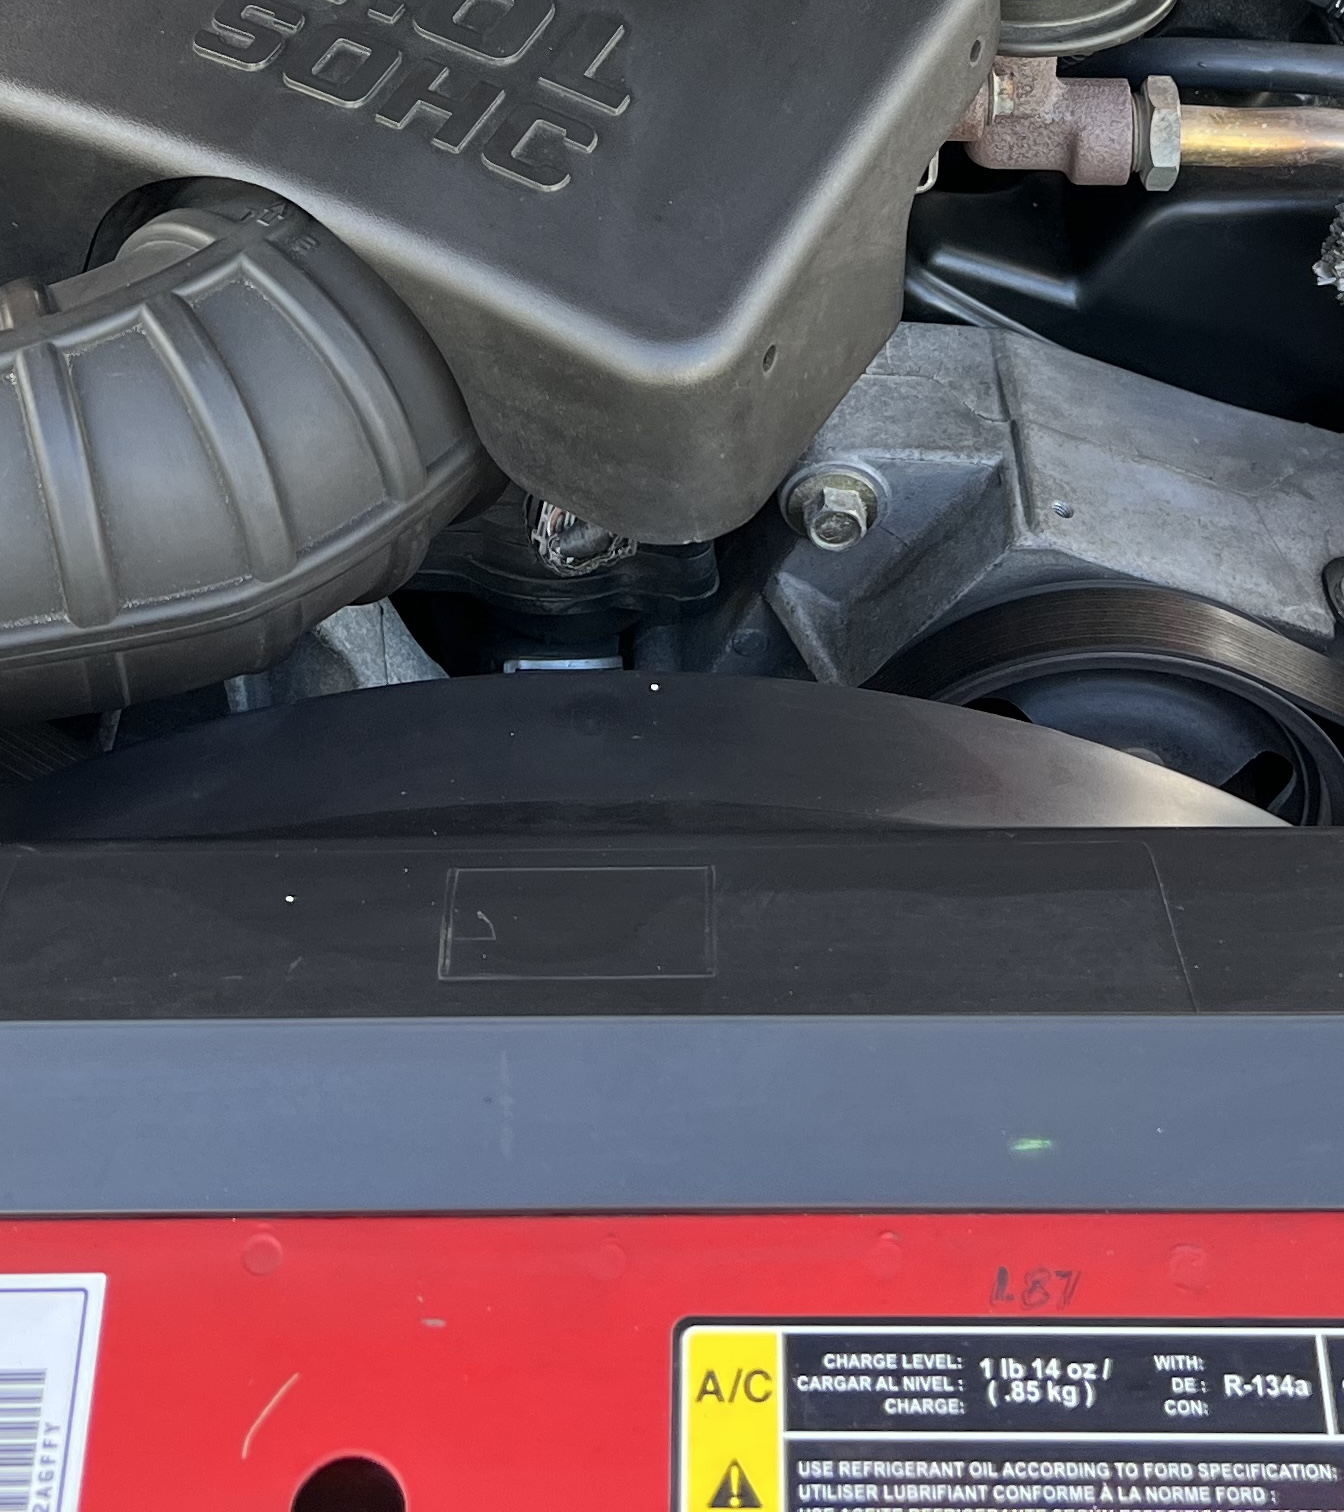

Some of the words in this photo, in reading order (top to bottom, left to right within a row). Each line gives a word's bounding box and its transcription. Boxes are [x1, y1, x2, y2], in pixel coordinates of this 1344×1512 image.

[823, 1353, 897, 1370] CHARGE
[902, 1353, 963, 1370] LEVEL:
[979, 1357, 993, 1379] 1
[1000, 1357, 1025, 1379] lb
[1031, 1357, 1061, 1379] 14
[1067, 1362, 1097, 1380] oz
[1154, 1354, 1205, 1372] WITH:
[696, 1368, 772, 1403] A/C
[796, 1375, 872, 1392] CARGAR
[876, 1376, 898, 1392] AL
[1047, 1380, 1080, 1408] kg
[1224, 1374, 1313, 1398] R-134a
[884, 1398, 964, 1415] CHARGE:
[1164, 1399, 1209, 1416] CON:
[798, 1460, 833, 1478] USE
[839, 1460, 964, 1479] REFRIGERANT
[969, 1461, 998, 1479] OIL
[1002, 1461, 1111, 1480] ACCORDING
[1114, 1462, 1139, 1480] TO
[1143, 1462, 1194, 1481] FORD
[1197, 1463, 1339, 1482] SPECIFICATION:
[798, 1484, 879, 1502] UTILISER
[883, 1484, 988, 1503] LUBRIFIANT
[992, 1485, 1095, 1503] CONFORME
[1100, 1482, 1113, 1503] À
[1117, 1485, 1141, 1504] LA
[1145, 1486, 1211, 1504] NORME
[1215, 1486, 1267, 1505] FORD
